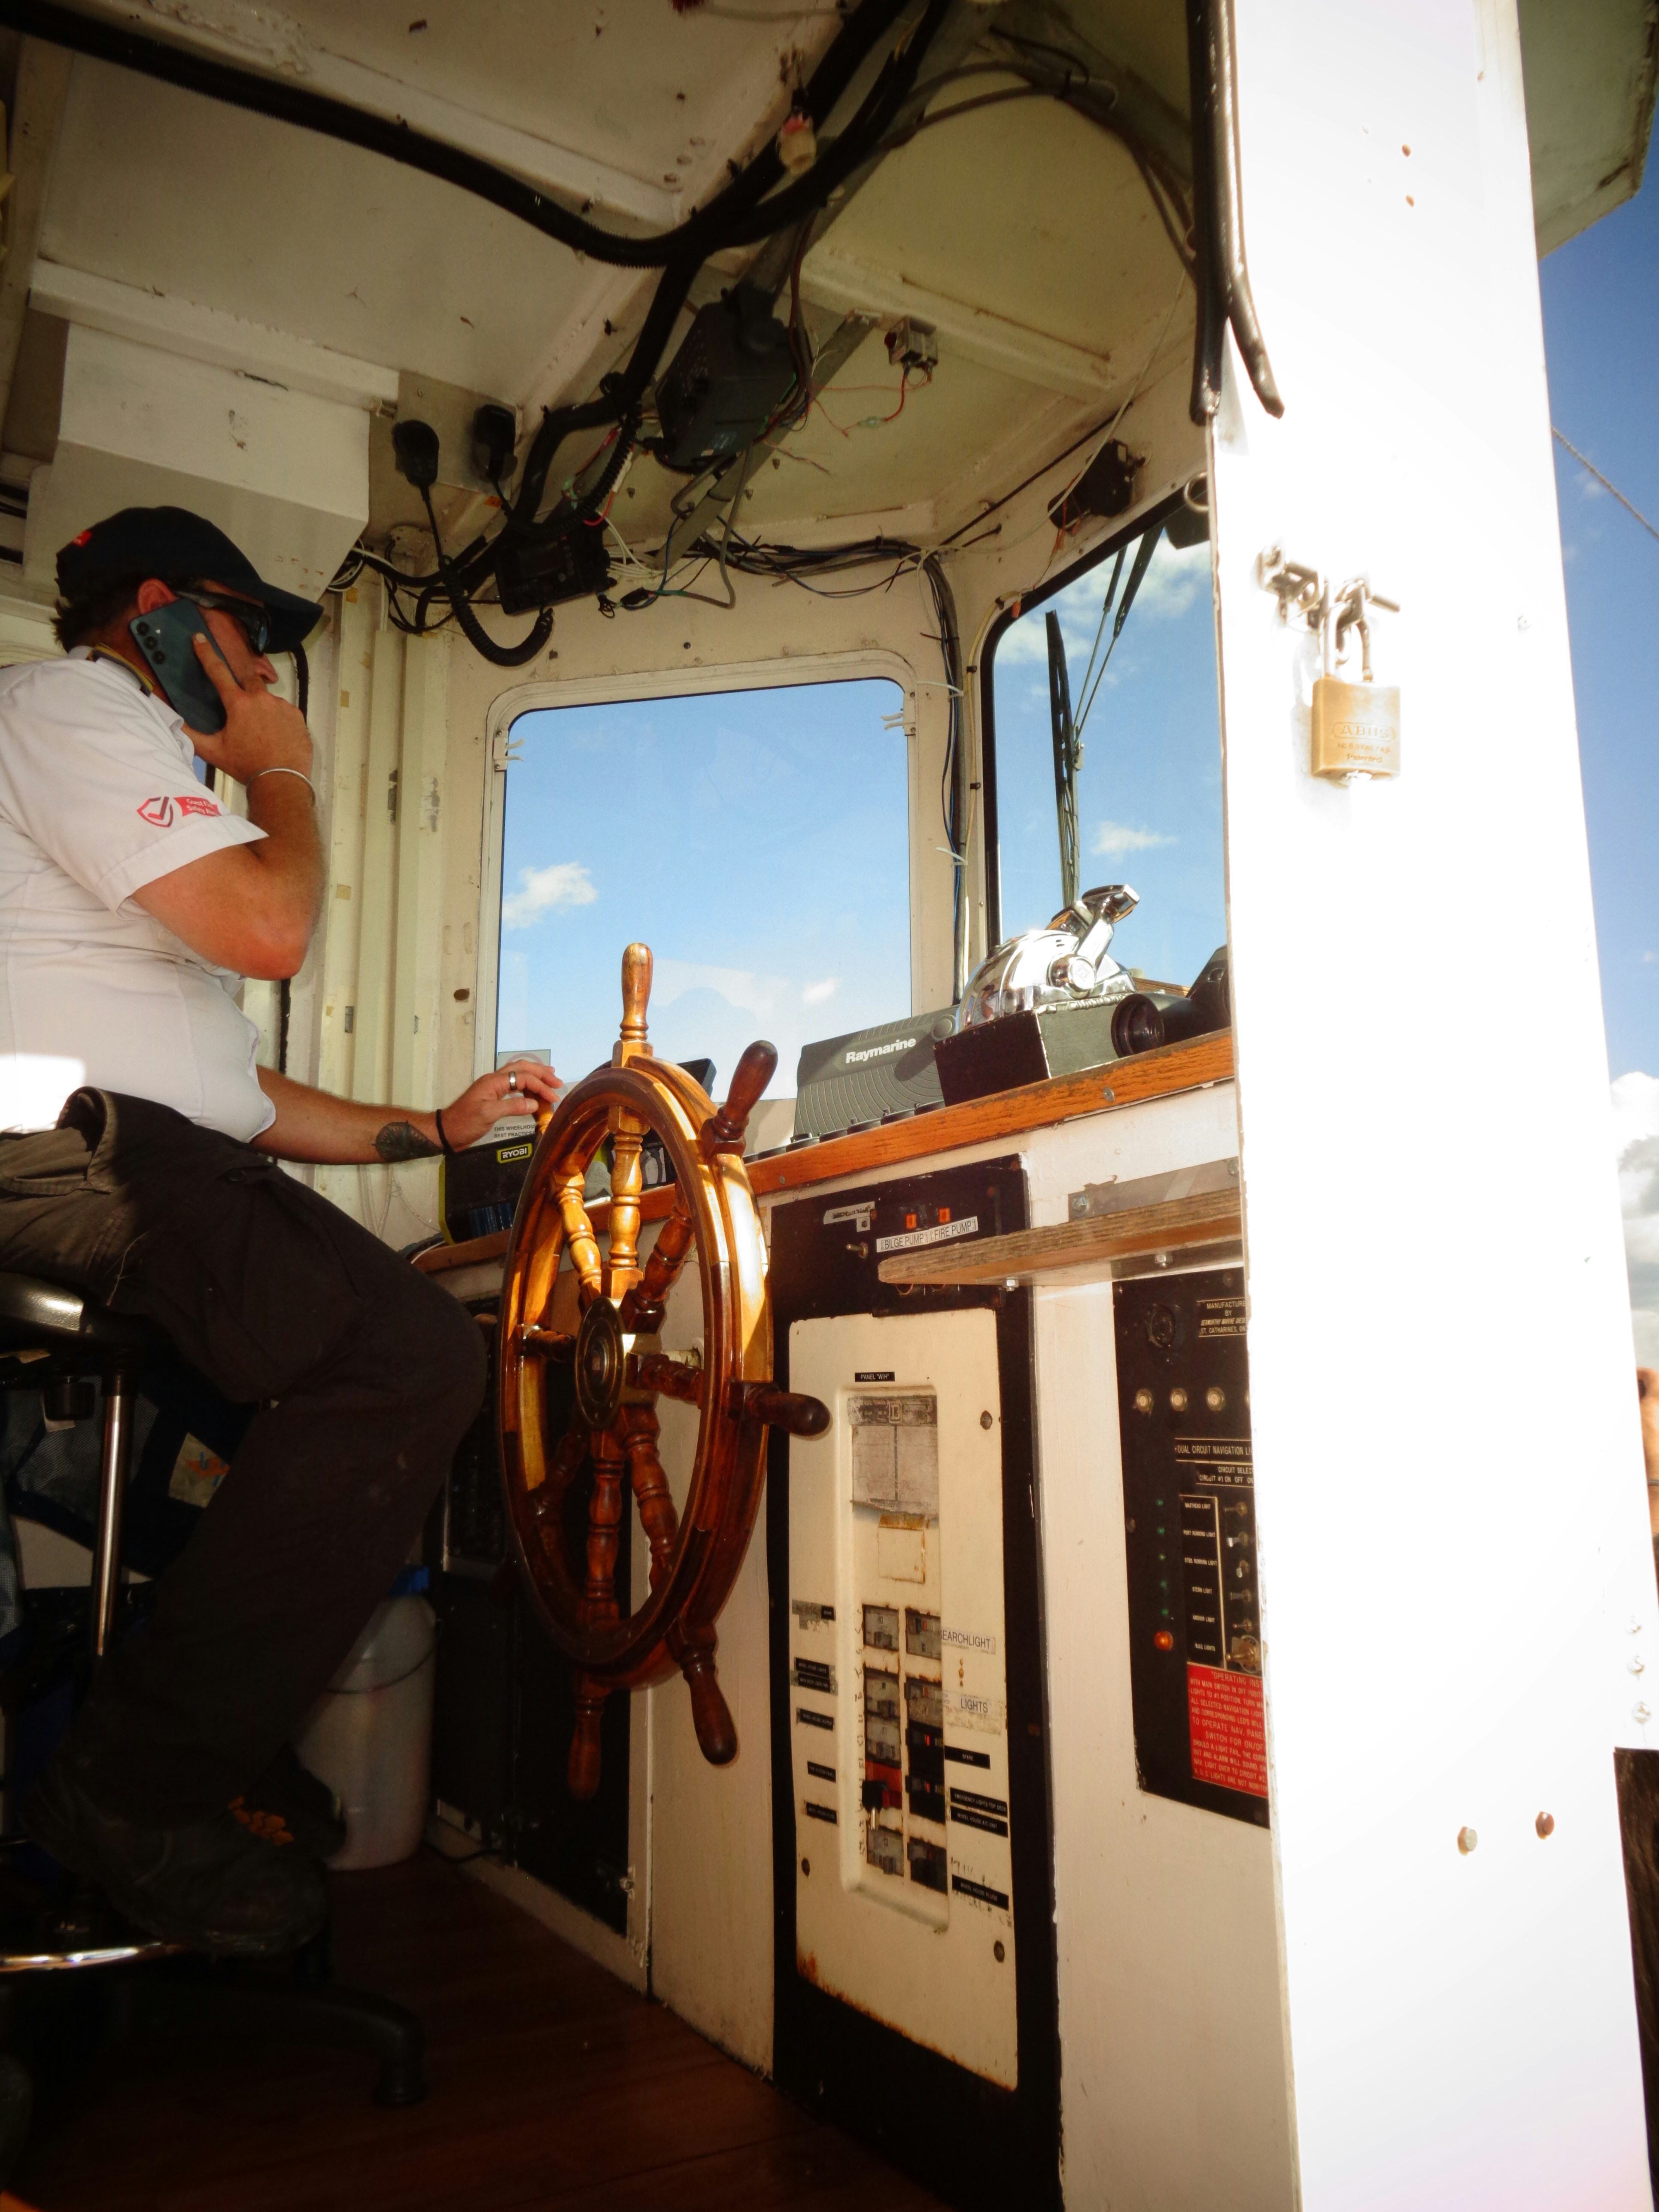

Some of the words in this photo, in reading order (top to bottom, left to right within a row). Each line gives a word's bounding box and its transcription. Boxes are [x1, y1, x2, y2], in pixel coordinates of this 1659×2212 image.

[1340, 725, 1389, 738] ABUS
[846, 1038, 916, 1063] Raymarine
[502, 1148, 527, 1158] RYOBI
[934, 1228, 949, 1240] FIRE
[952, 1221, 972, 1235] PUMP
[885, 1238, 903, 1249] BILGE
[905, 1234, 924, 1246] PUMP
[1178, 1445, 1191, 1453] DUAL
[1192, 1445, 1211, 1454] CIRCUIT
[1213, 1446, 1243, 1455] NAVIGATION
[1214, 1683, 1230, 1692] SWITCH
[1191, 1688, 1205, 1696] LIGHTS
[1243, 1698, 1255, 1707] TURN
[961, 1698, 988, 1713] LIGHTS
[1200, 1699, 1222, 1710] SELECTED
[1223, 1704, 1249, 1715] NAVIGATION
[1201, 1709, 1236, 1723] CORRESPONDING
[1193, 1717, 1199, 1725] TO
[1202, 1720, 1228, 1732] OPERATE
[1206, 1731, 1227, 1743] SWITCH
[1230, 1737, 1242, 1746] FOR
[1193, 1739, 1209, 1748] SHOULD
[1215, 1745, 1228, 1753] LIGHT
[1243, 1751, 1251, 1759] THE
[1213, 1754, 1228, 1763] ALARM
[1230, 1758, 1240, 1766] WILL
[1205, 1761, 1216, 1769] LIGHT
[1218, 1765, 1230, 1773] OVER
[1240, 1770, 1257, 1780] CIRCUIT
[1211, 1771, 1226, 1782] LIGHTS
[1228, 1776, 1236, 1784] ARE
[1238, 1778, 1246, 1787] NOT
[954, 1793, 975, 1802] EMERGENCY
[976, 1799, 988, 1807] LIGHTS
[957, 1812, 969, 1820] WHEEL
